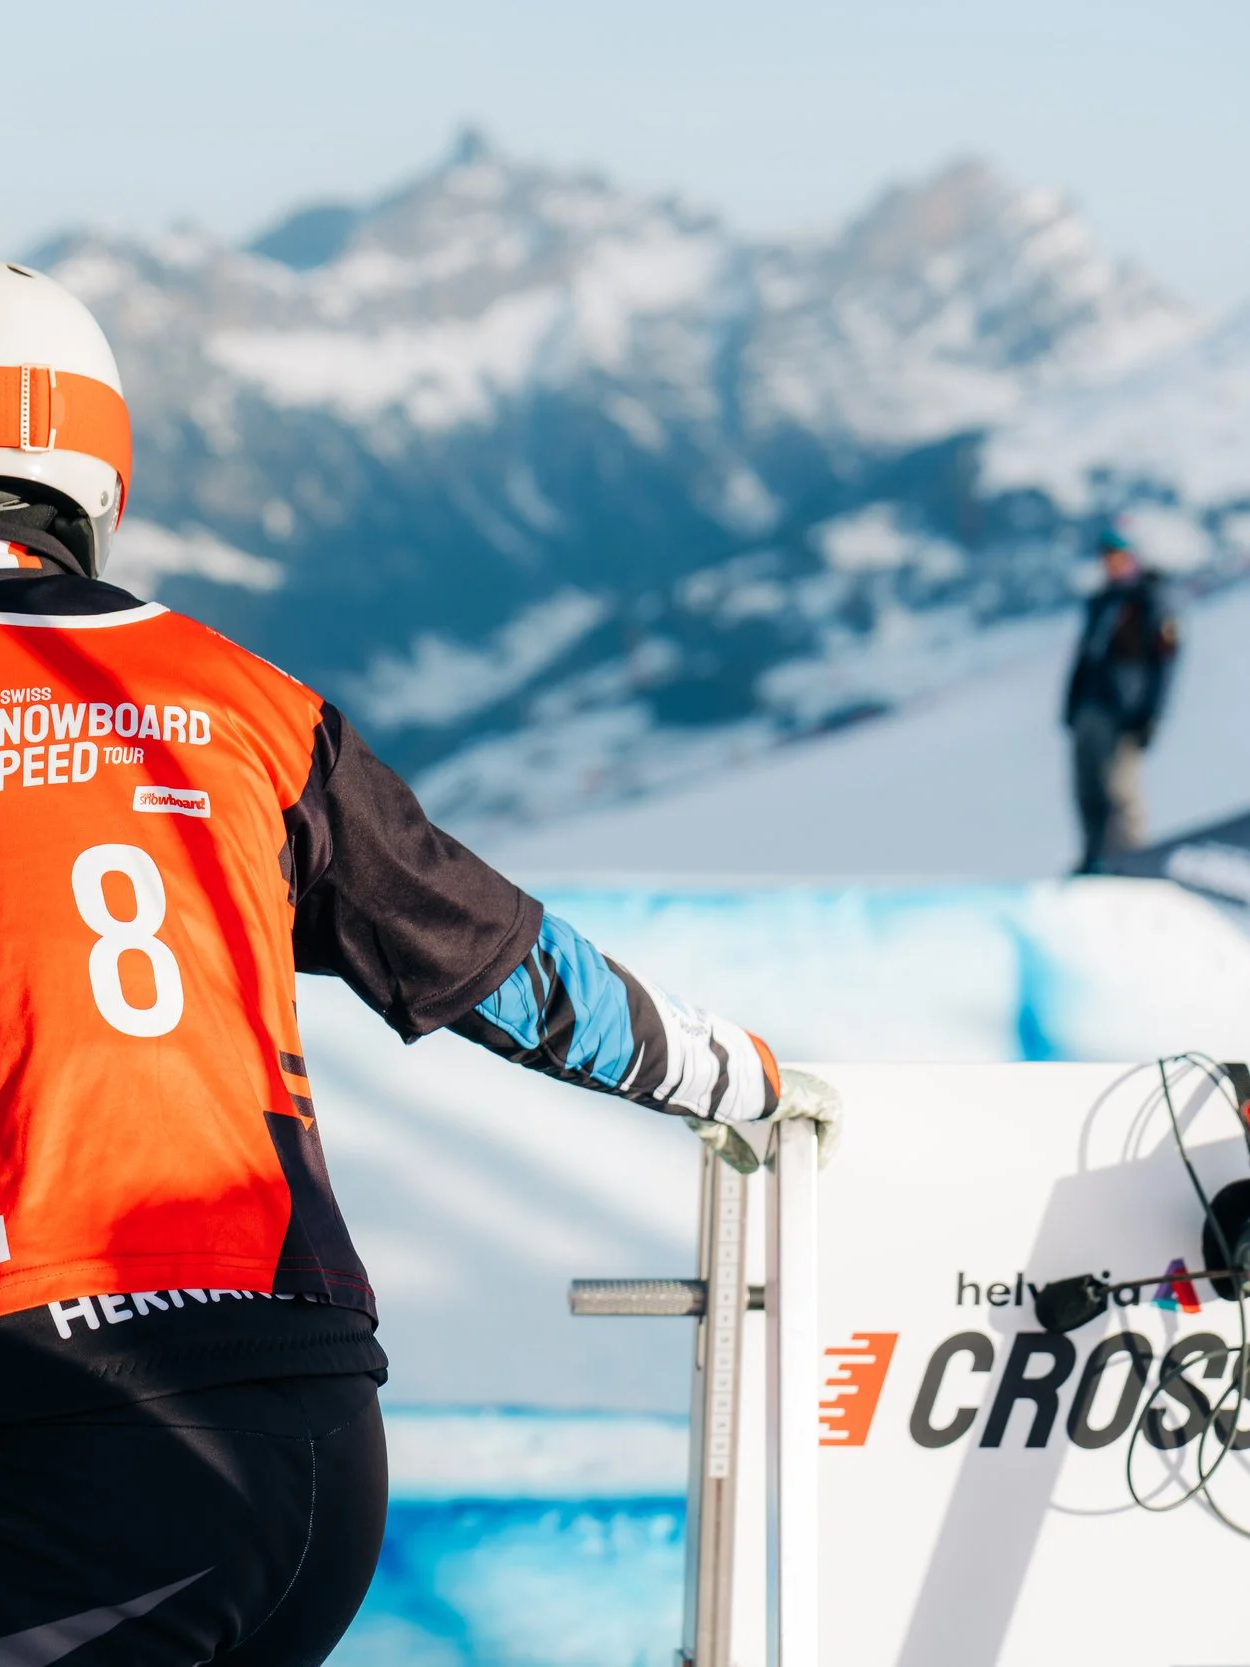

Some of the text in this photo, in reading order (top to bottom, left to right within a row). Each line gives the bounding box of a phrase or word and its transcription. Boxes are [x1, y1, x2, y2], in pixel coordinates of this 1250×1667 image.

[0, 687, 52, 705] SWISS
[103, 746, 145, 765] TOUR
[71, 843, 185, 1038] 8
